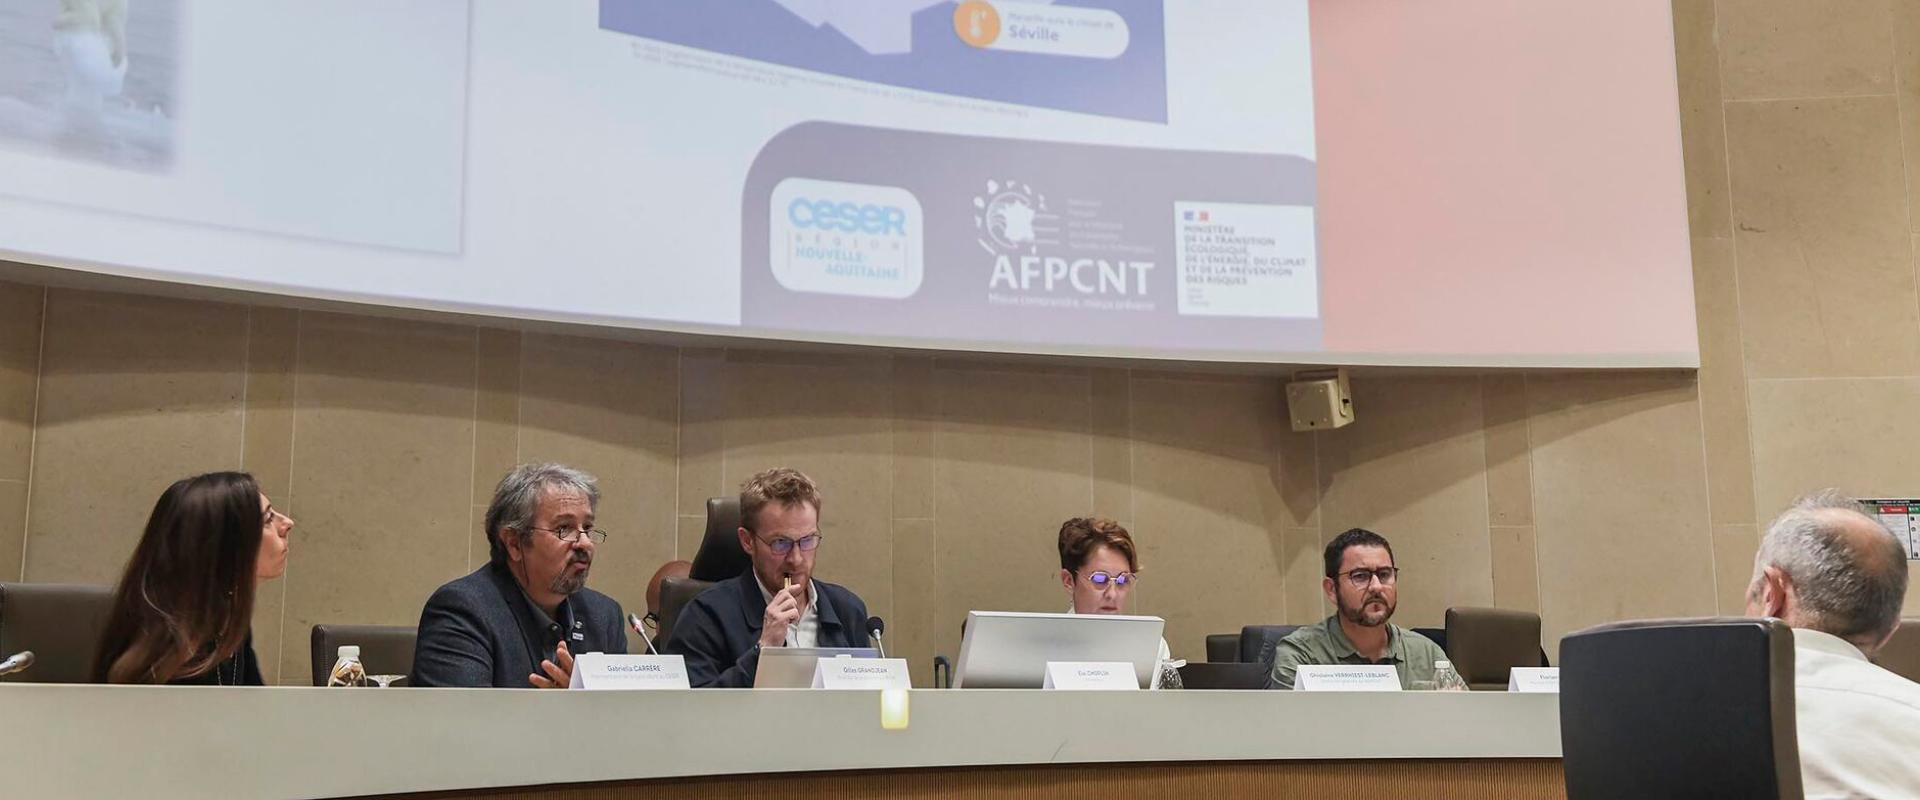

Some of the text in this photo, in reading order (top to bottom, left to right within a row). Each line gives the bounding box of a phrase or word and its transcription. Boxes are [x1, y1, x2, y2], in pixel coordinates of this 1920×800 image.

[1008, 24, 1060, 41] Séville
[1200, 235, 1212, 243] LA
[1215, 235, 1276, 246] TRANSITION
[1253, 257, 1268, 266] DU
[1270, 256, 1307, 266] CLIMAT
[988, 254, 1156, 295] AFPCNT
[1185, 264, 1197, 274] ET
[1199, 265, 1212, 274] DE
[1215, 265, 1227, 274] LA
[1185, 274, 1248, 286] DES RISQUES
